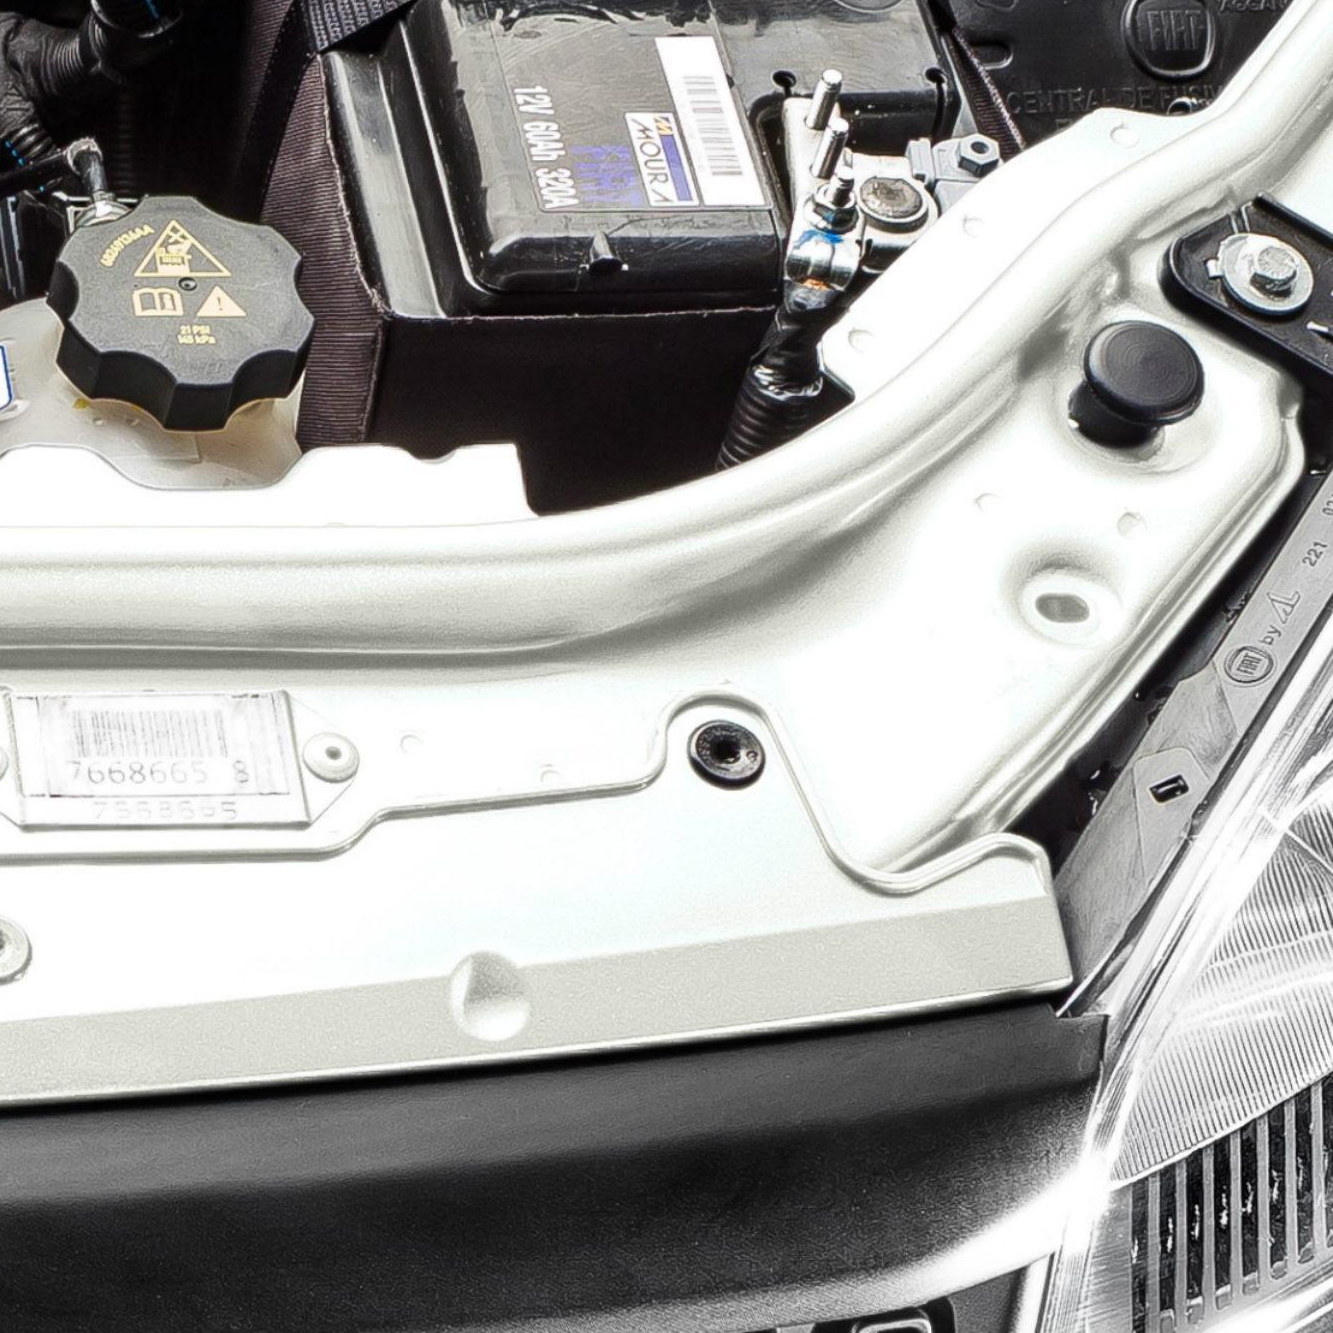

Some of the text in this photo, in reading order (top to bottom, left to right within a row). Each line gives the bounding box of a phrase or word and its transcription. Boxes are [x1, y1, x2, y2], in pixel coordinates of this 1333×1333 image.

[1145, 9, 1204, 51] FIAT
[514, 85, 580, 209] 12V 60Ah 320A
[631, 116, 675, 204] MOURA
[1236, 652, 1263, 675] FIAT
[1259, 625, 1282, 646] by
[1301, 540, 1328, 567] 221
[65, 759, 250, 784] 7668665 8
